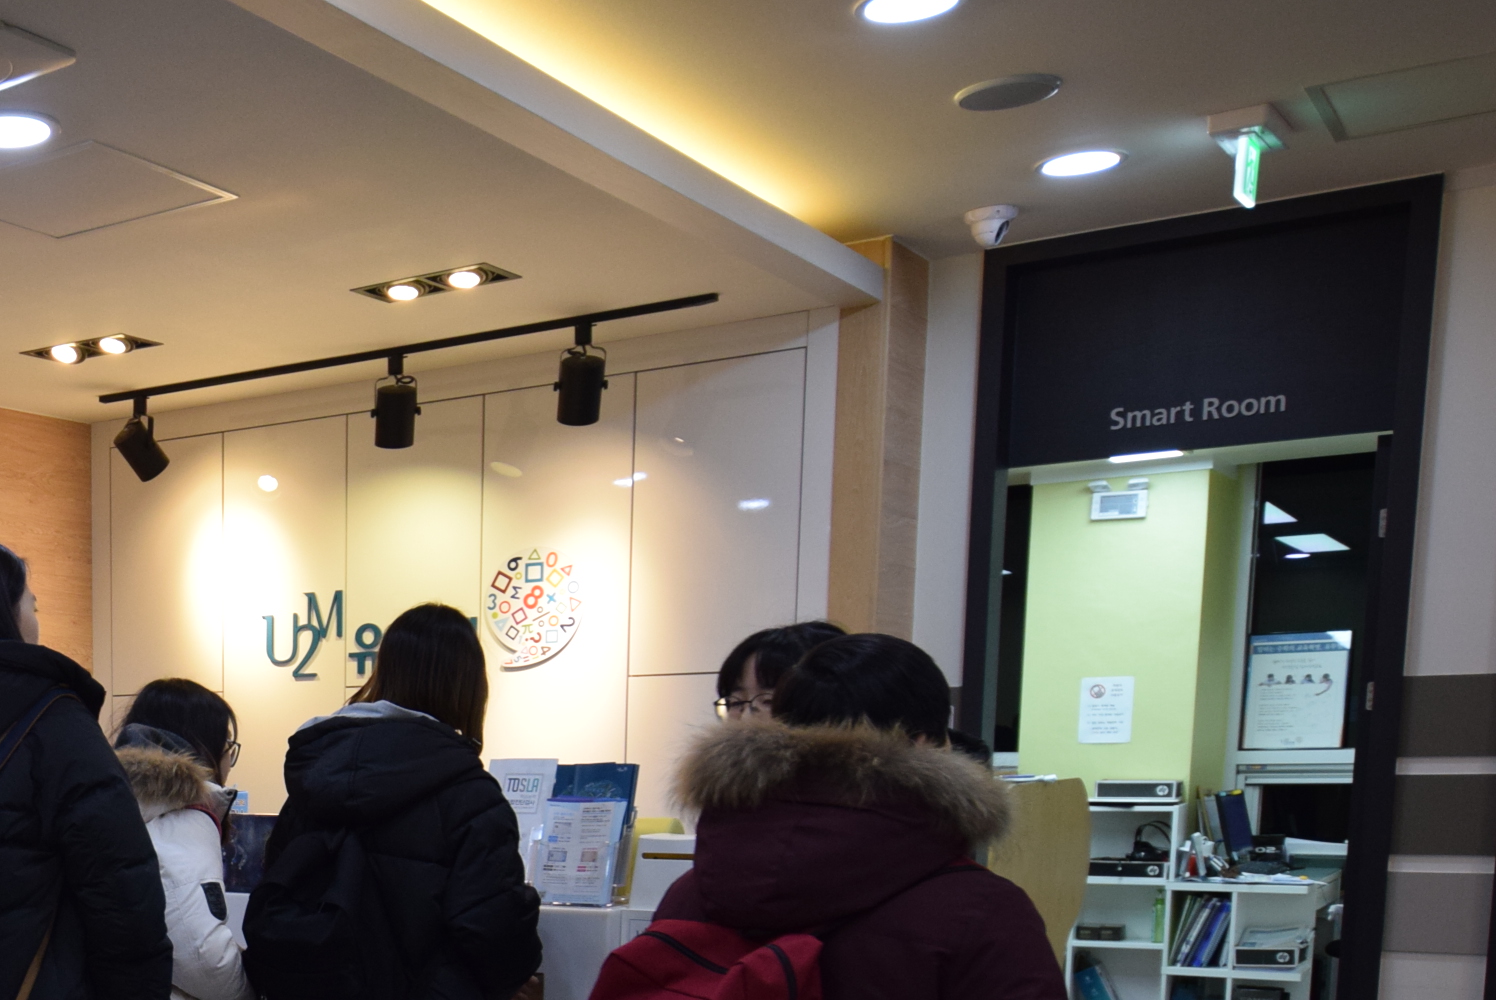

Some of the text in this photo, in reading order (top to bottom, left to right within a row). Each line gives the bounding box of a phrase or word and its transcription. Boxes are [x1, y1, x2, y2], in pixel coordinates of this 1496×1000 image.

[1109, 393, 1287, 431] Smart Room
[507, 777, 540, 793] TOSLA
